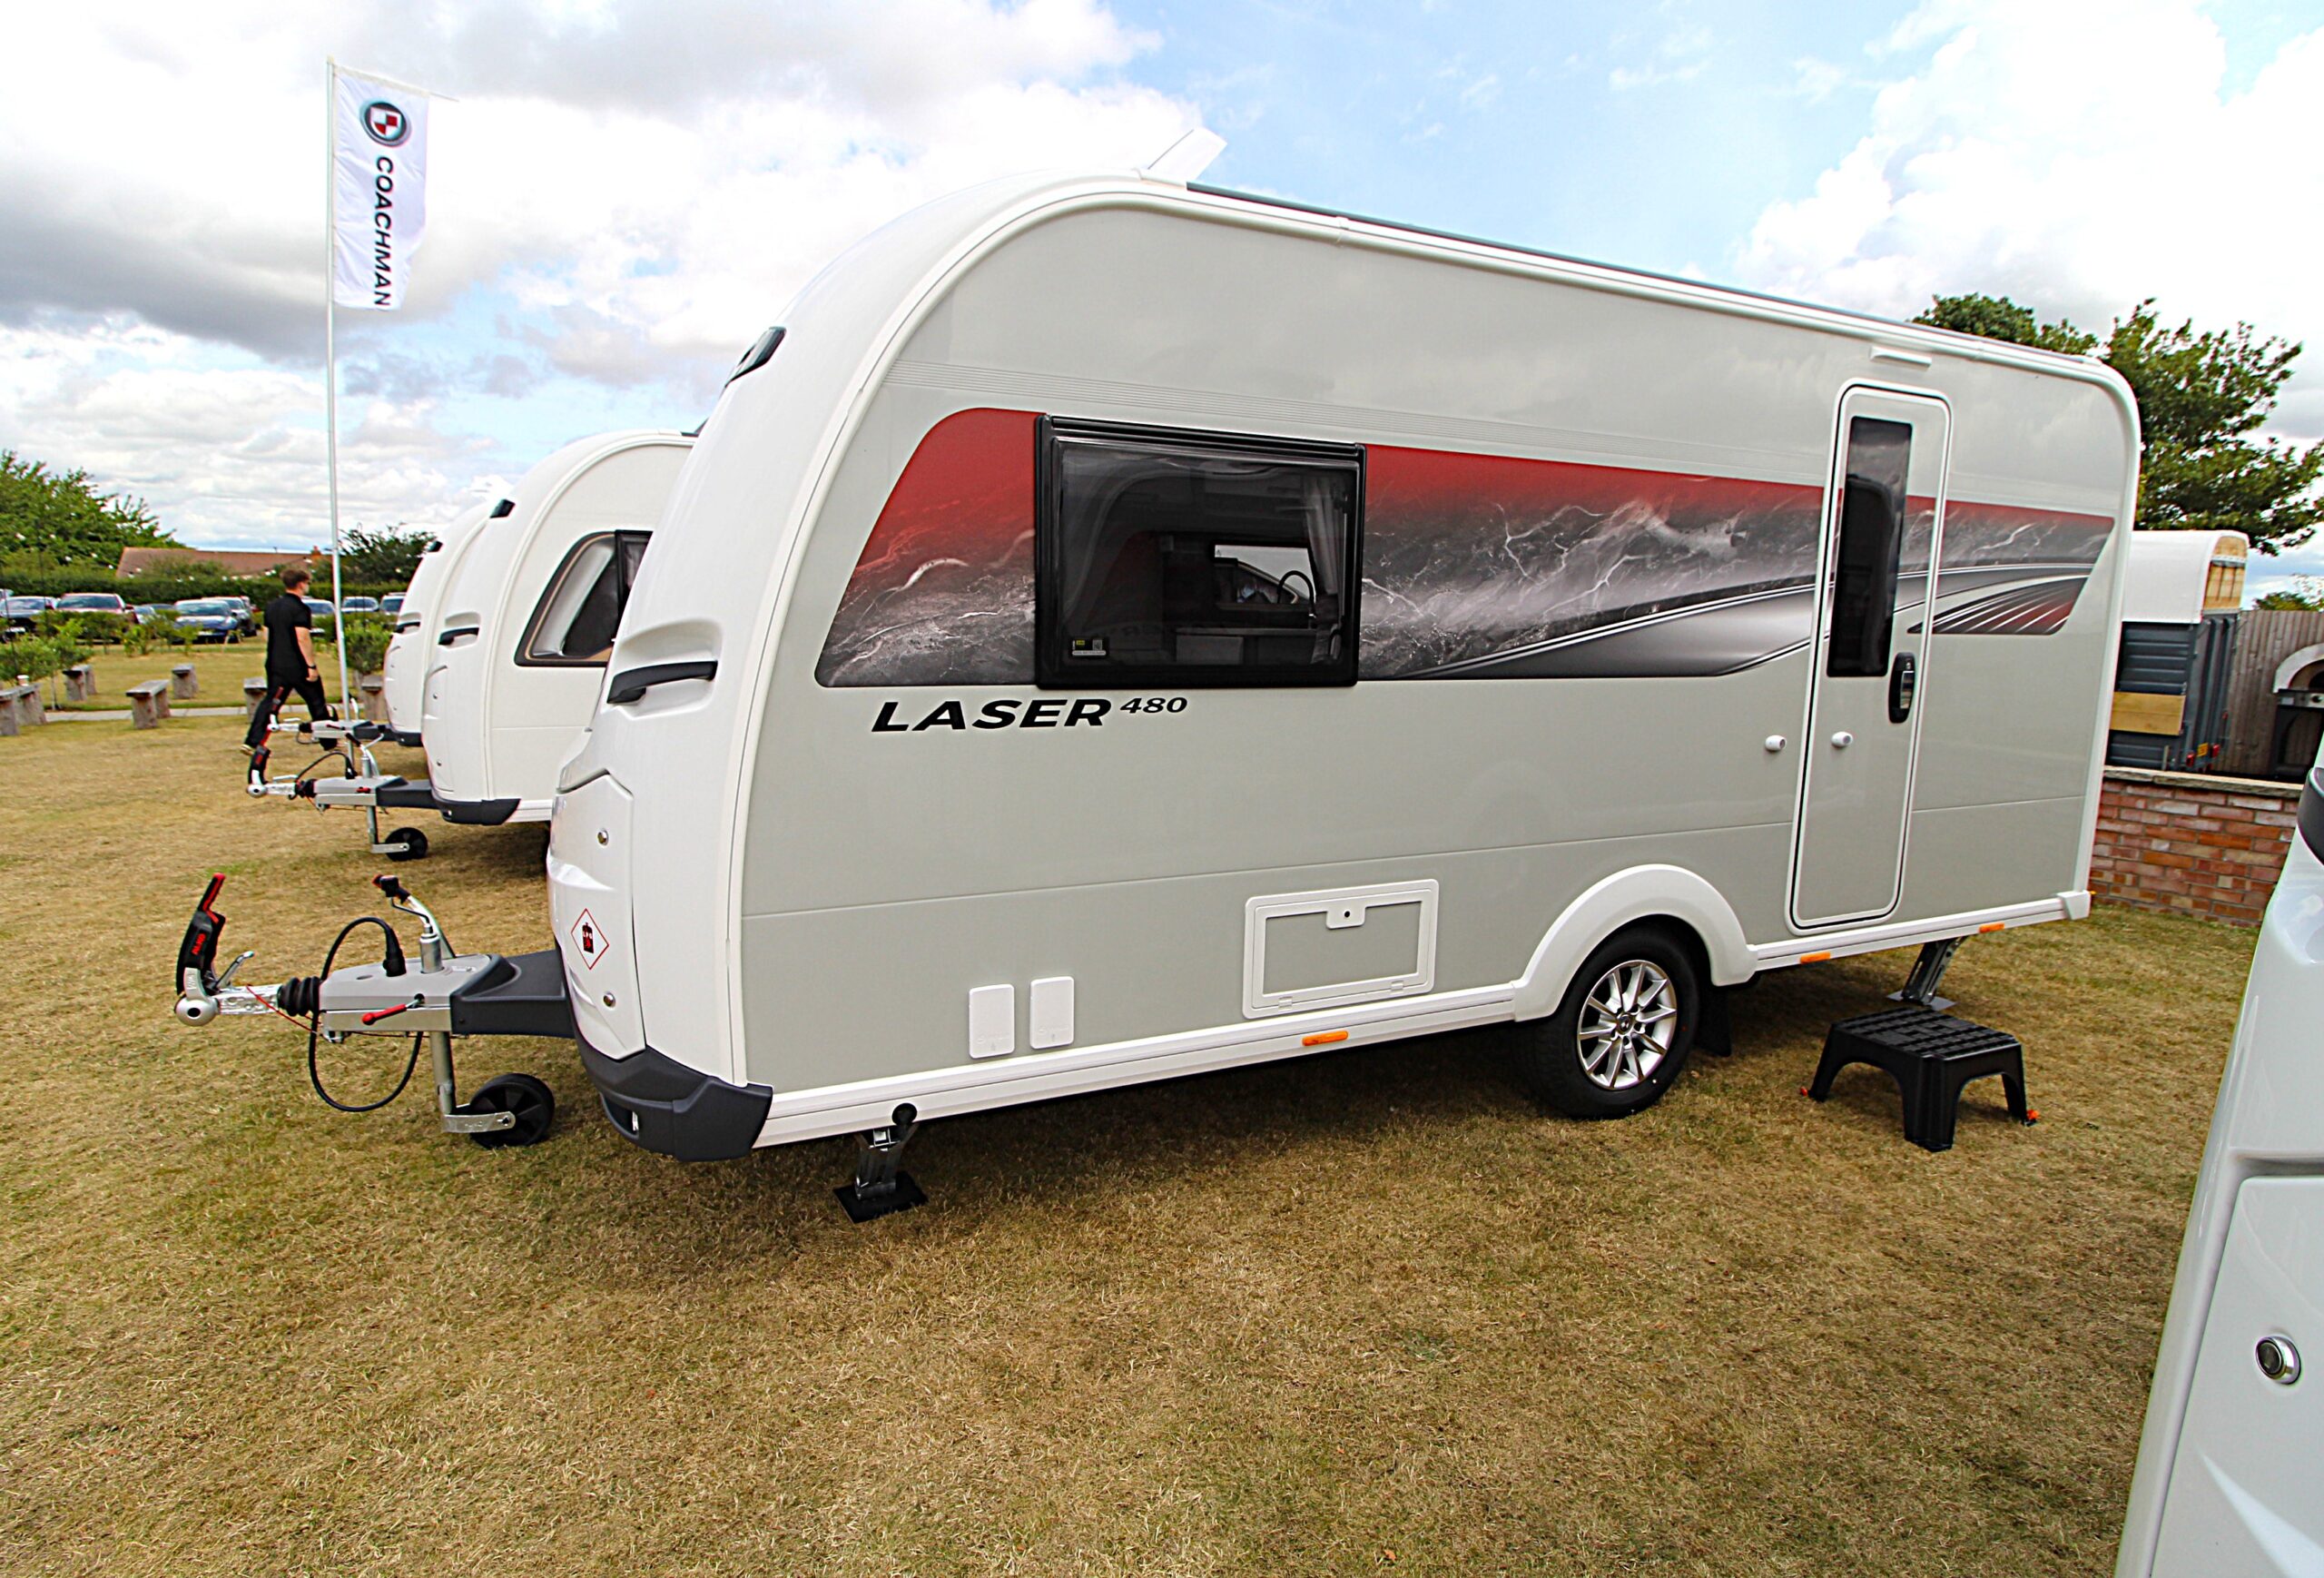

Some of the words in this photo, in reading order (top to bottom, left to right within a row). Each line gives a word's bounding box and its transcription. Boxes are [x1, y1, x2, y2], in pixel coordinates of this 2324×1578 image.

[374, 155, 393, 306] COACHMAN
[871, 699, 1111, 732] LASER
[1120, 697, 1188, 714] 480
